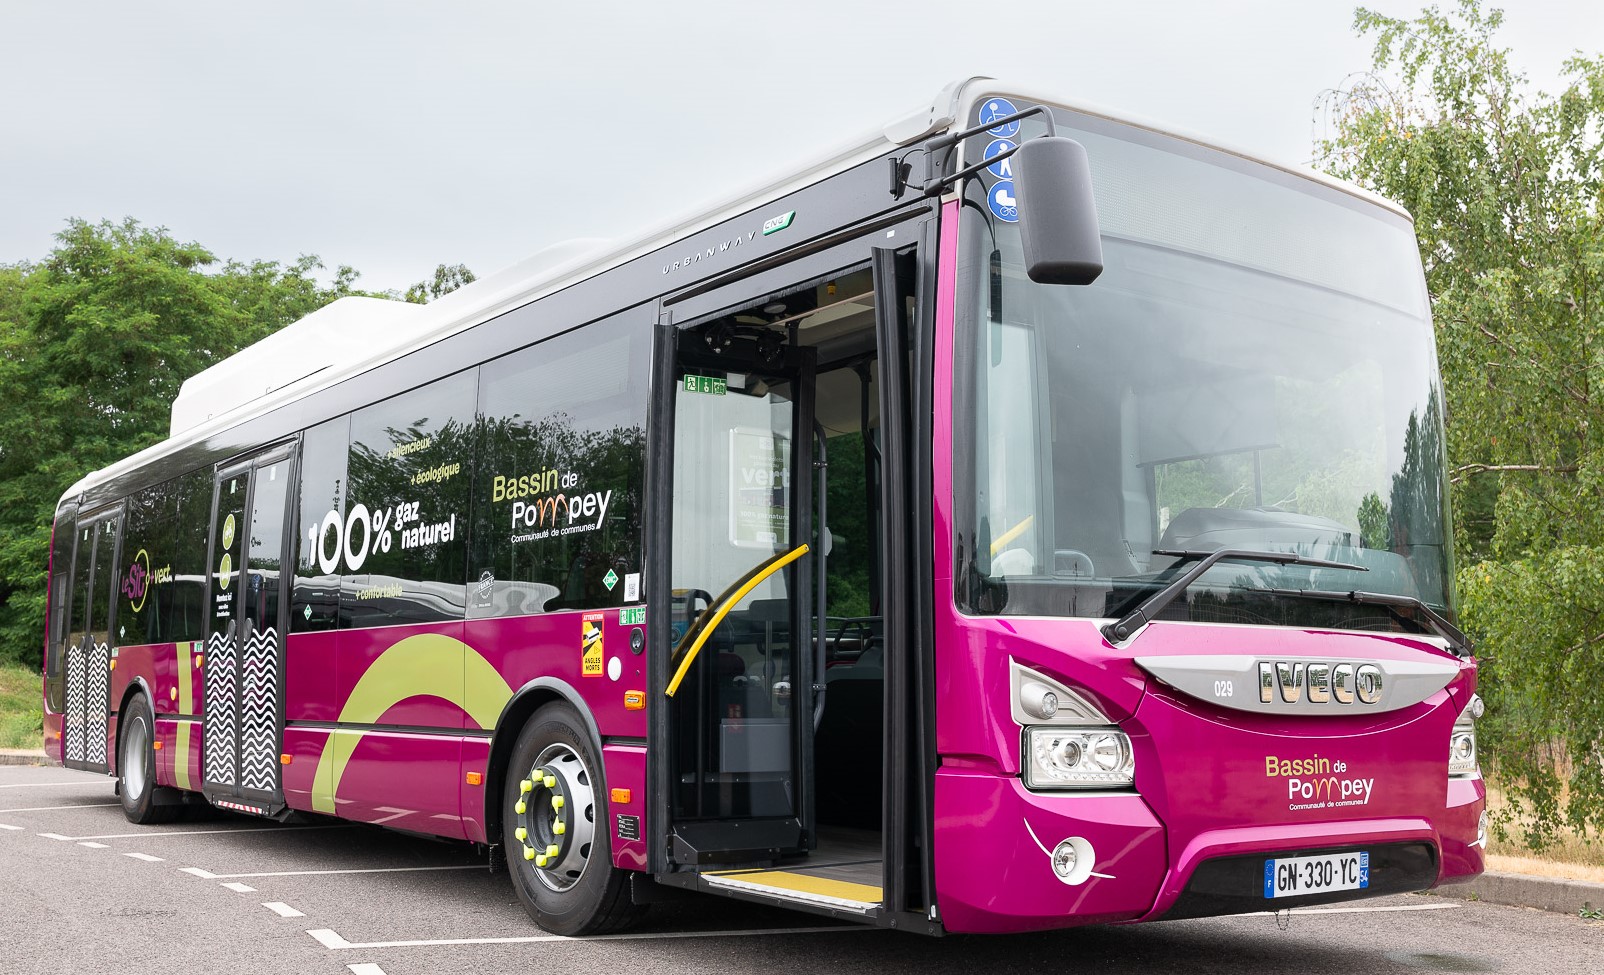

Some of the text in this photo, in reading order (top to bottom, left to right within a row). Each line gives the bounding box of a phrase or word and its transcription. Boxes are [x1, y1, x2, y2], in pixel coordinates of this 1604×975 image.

[764, 215, 785, 230] CNG
[492, 466, 578, 502] Bassin de
[394, 501, 420, 531] gaz
[511, 489, 612, 530] Pompey
[308, 503, 392, 574] 100%
[401, 513, 456, 549] naturel
[511, 523, 596, 543] Communauté de communes
[1214, 680, 1233, 697] 029
[1258, 661, 1384, 704] IVECO
[1265, 753, 1347, 777] Bassin de
[1288, 776, 1374, 804] Pompey
[1289, 801, 1326, 811] Communauté
[1335, 799, 1364, 807] communes
[1267, 879, 1272, 889] F
